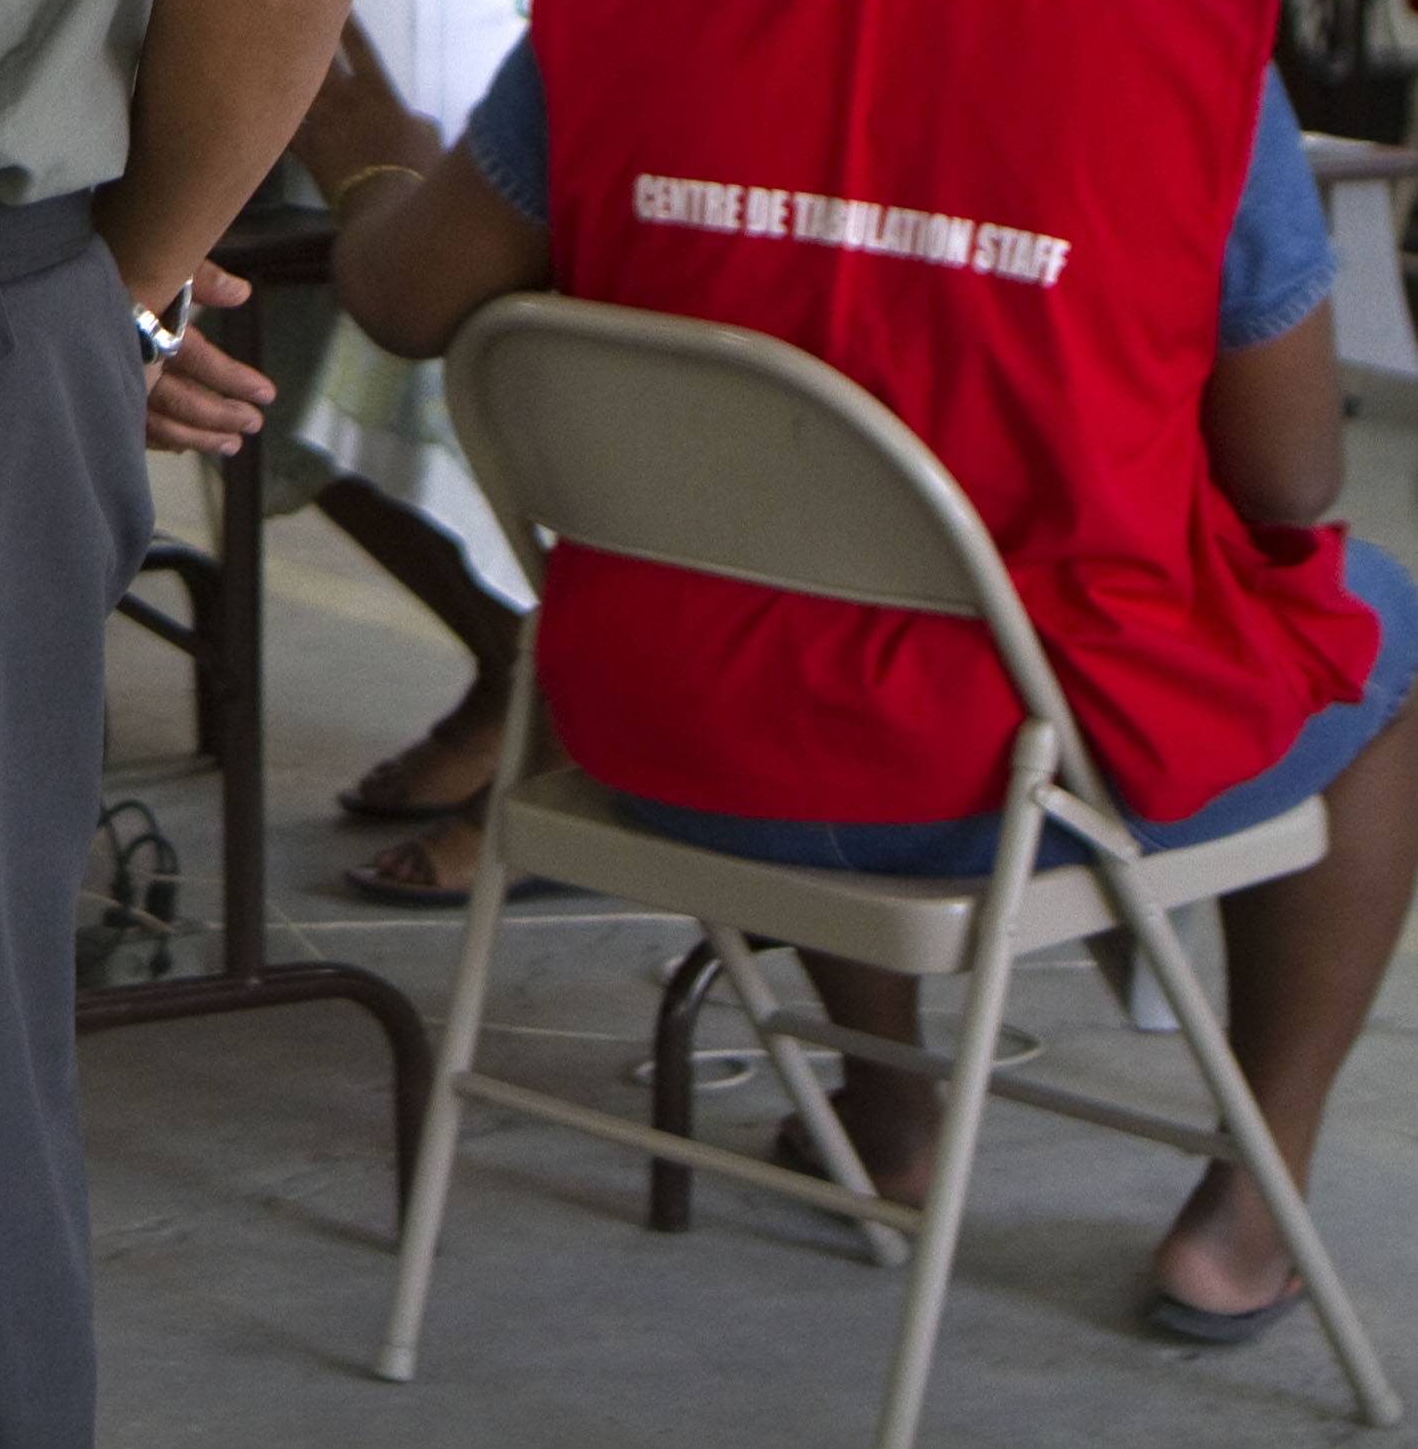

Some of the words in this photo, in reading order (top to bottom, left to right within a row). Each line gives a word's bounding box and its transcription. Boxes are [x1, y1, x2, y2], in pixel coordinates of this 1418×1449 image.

[634, 173, 742, 233] CENTRE
[745, 185, 789, 237] DE
[973, 222, 1071, 287] STAFF
